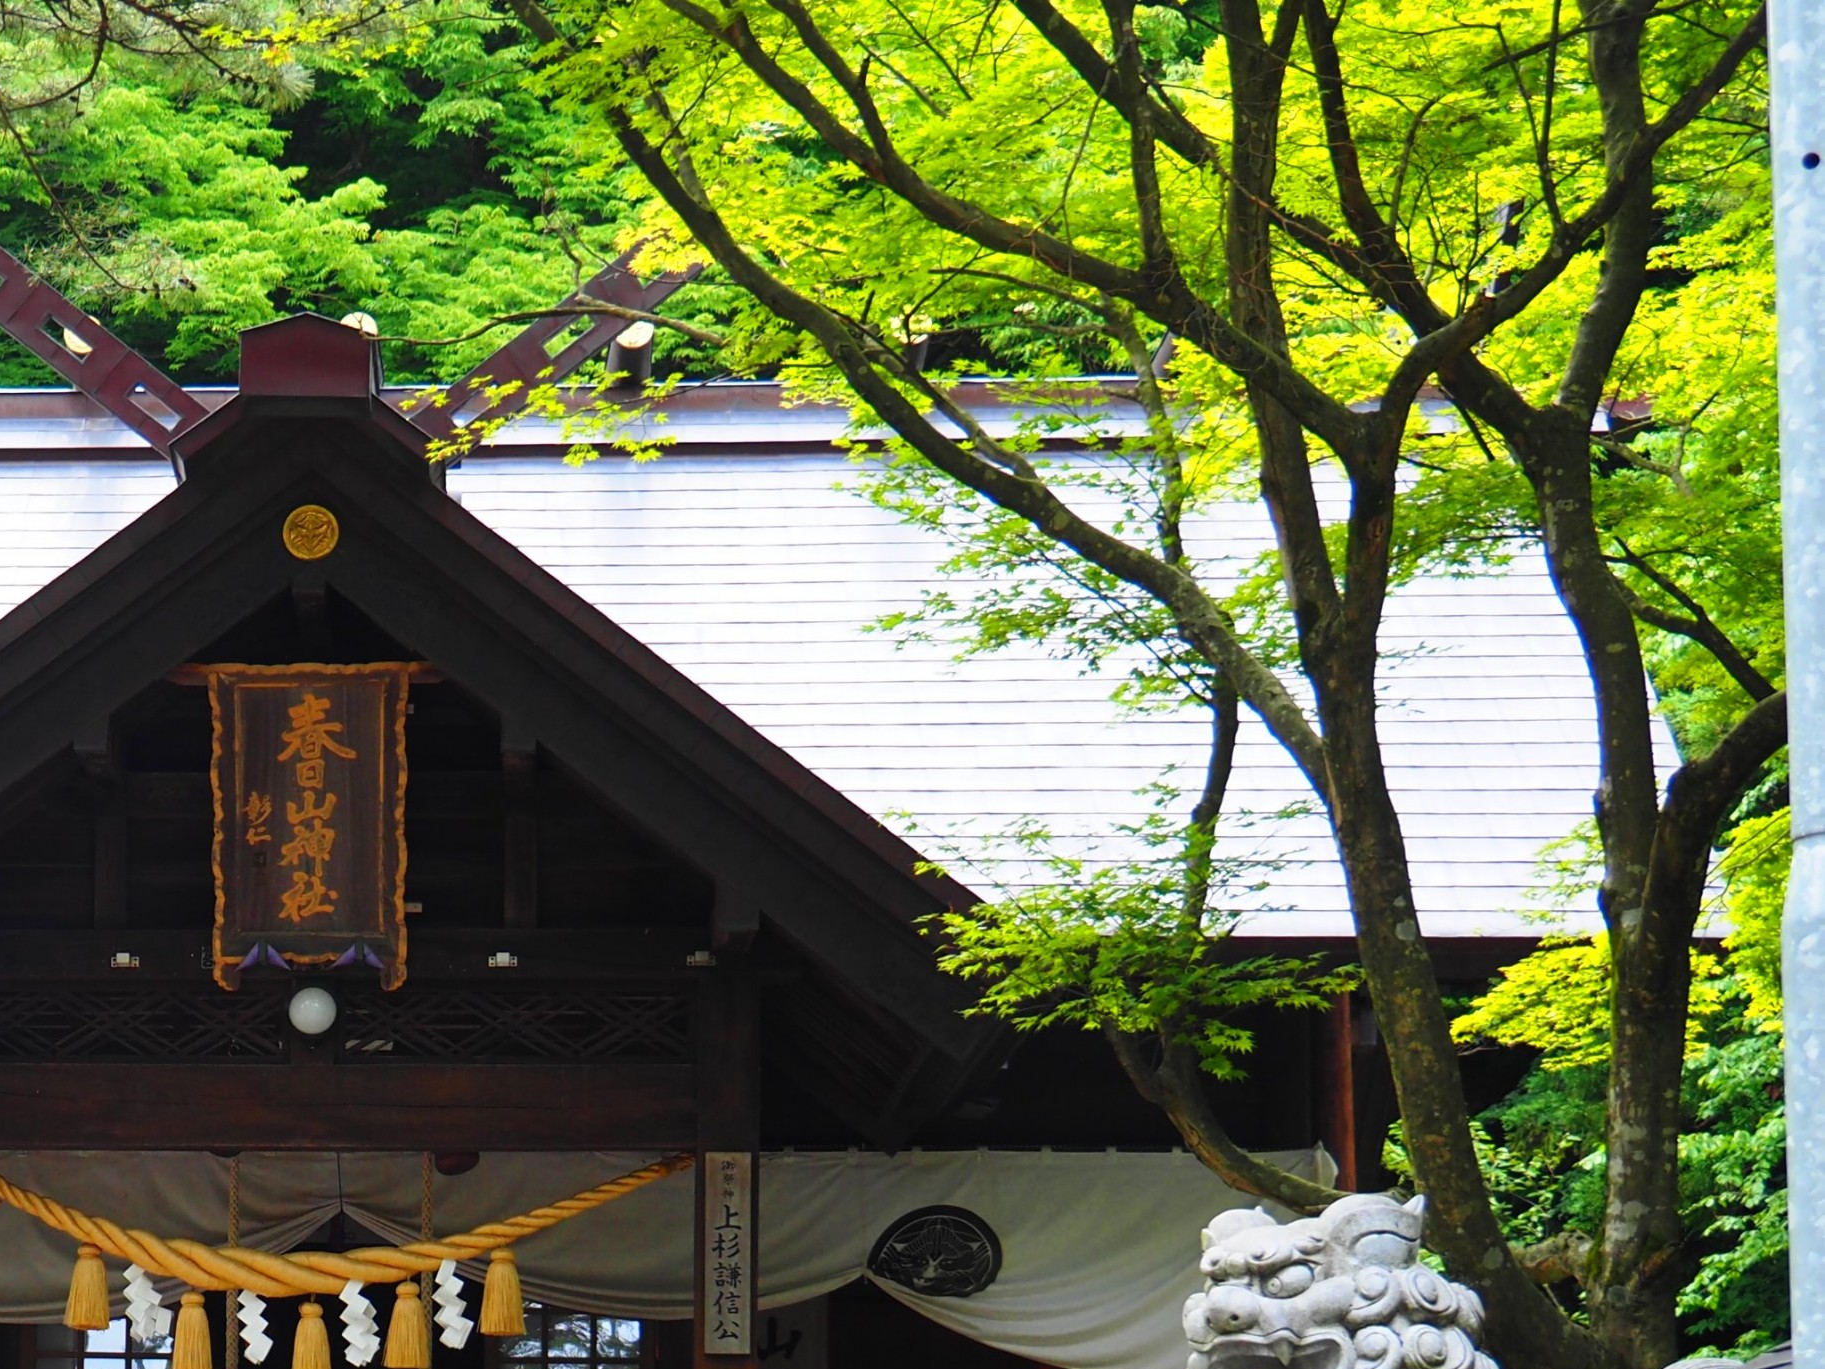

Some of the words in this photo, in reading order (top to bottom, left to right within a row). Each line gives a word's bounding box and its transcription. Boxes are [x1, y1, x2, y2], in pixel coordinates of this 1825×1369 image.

[277, 693, 358, 922] 春日山神社
[711, 1204, 742, 1341] 上杉謙信公
